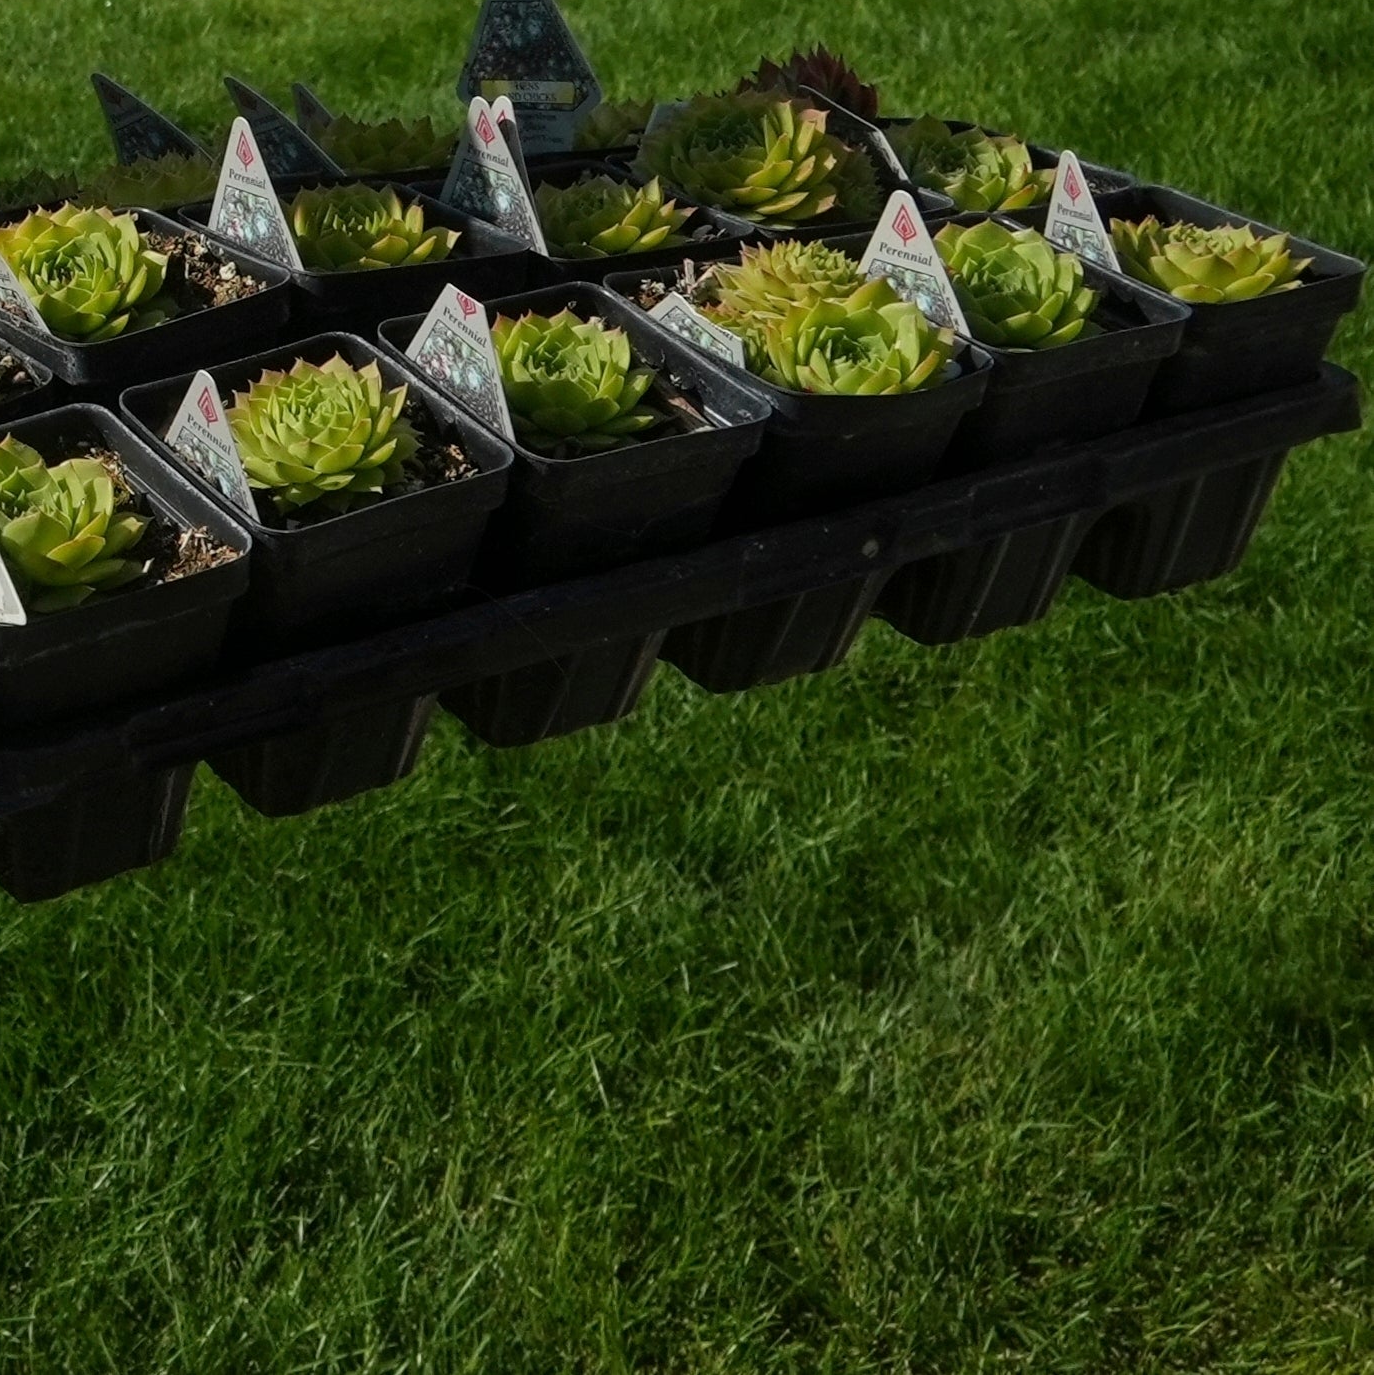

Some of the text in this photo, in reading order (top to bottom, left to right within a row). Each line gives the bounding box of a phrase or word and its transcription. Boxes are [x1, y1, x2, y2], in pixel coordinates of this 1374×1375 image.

[468, 143, 509, 168] Perennial
[229, 168, 266, 189] Perennial
[879, 241, 933, 267] Perennial
[443, 306, 487, 348] Perennial
[187, 412, 232, 456] Perennial
